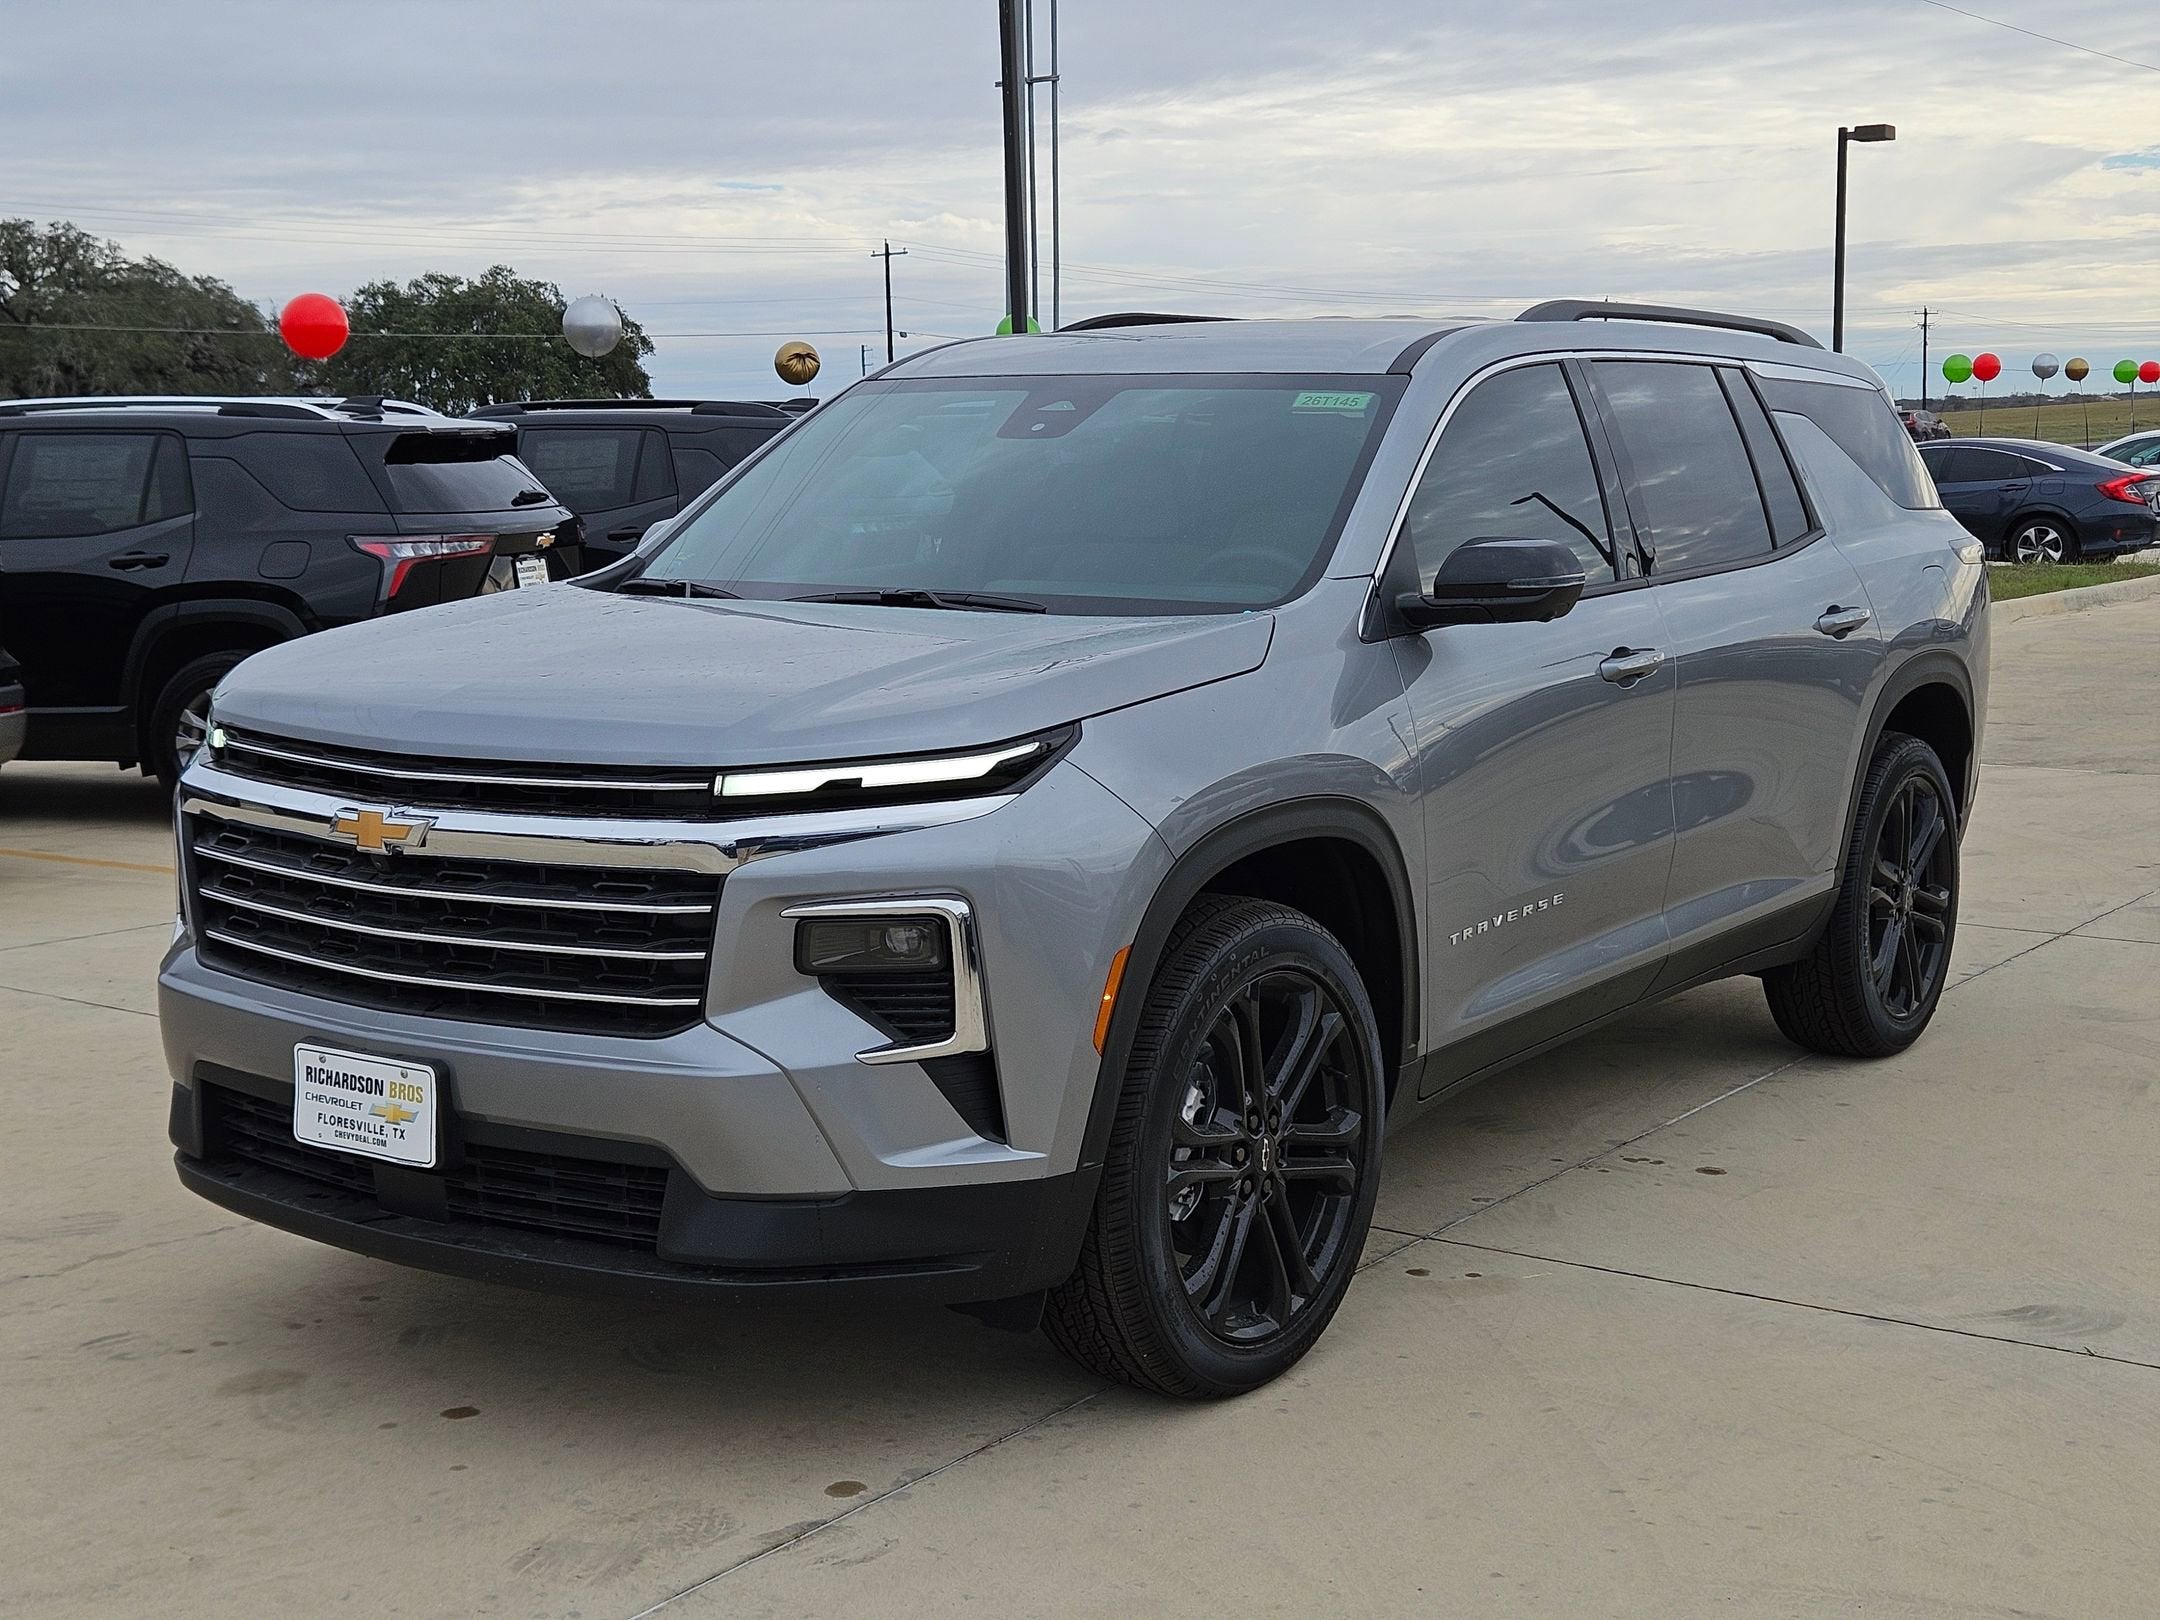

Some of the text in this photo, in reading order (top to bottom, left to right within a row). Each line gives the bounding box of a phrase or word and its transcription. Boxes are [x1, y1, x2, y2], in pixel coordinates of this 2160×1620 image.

[1302, 396, 1360, 407] 26T145
[1449, 893, 1564, 946] TRAVERSE
[305, 1065, 424, 1104] RICHARDSON BROS
[305, 1091, 363, 1111] CHEVROLET
[317, 1112, 406, 1140] FLORESVILLE, TX
[334, 1129, 387, 1148] CHEVYDEAL.COM
